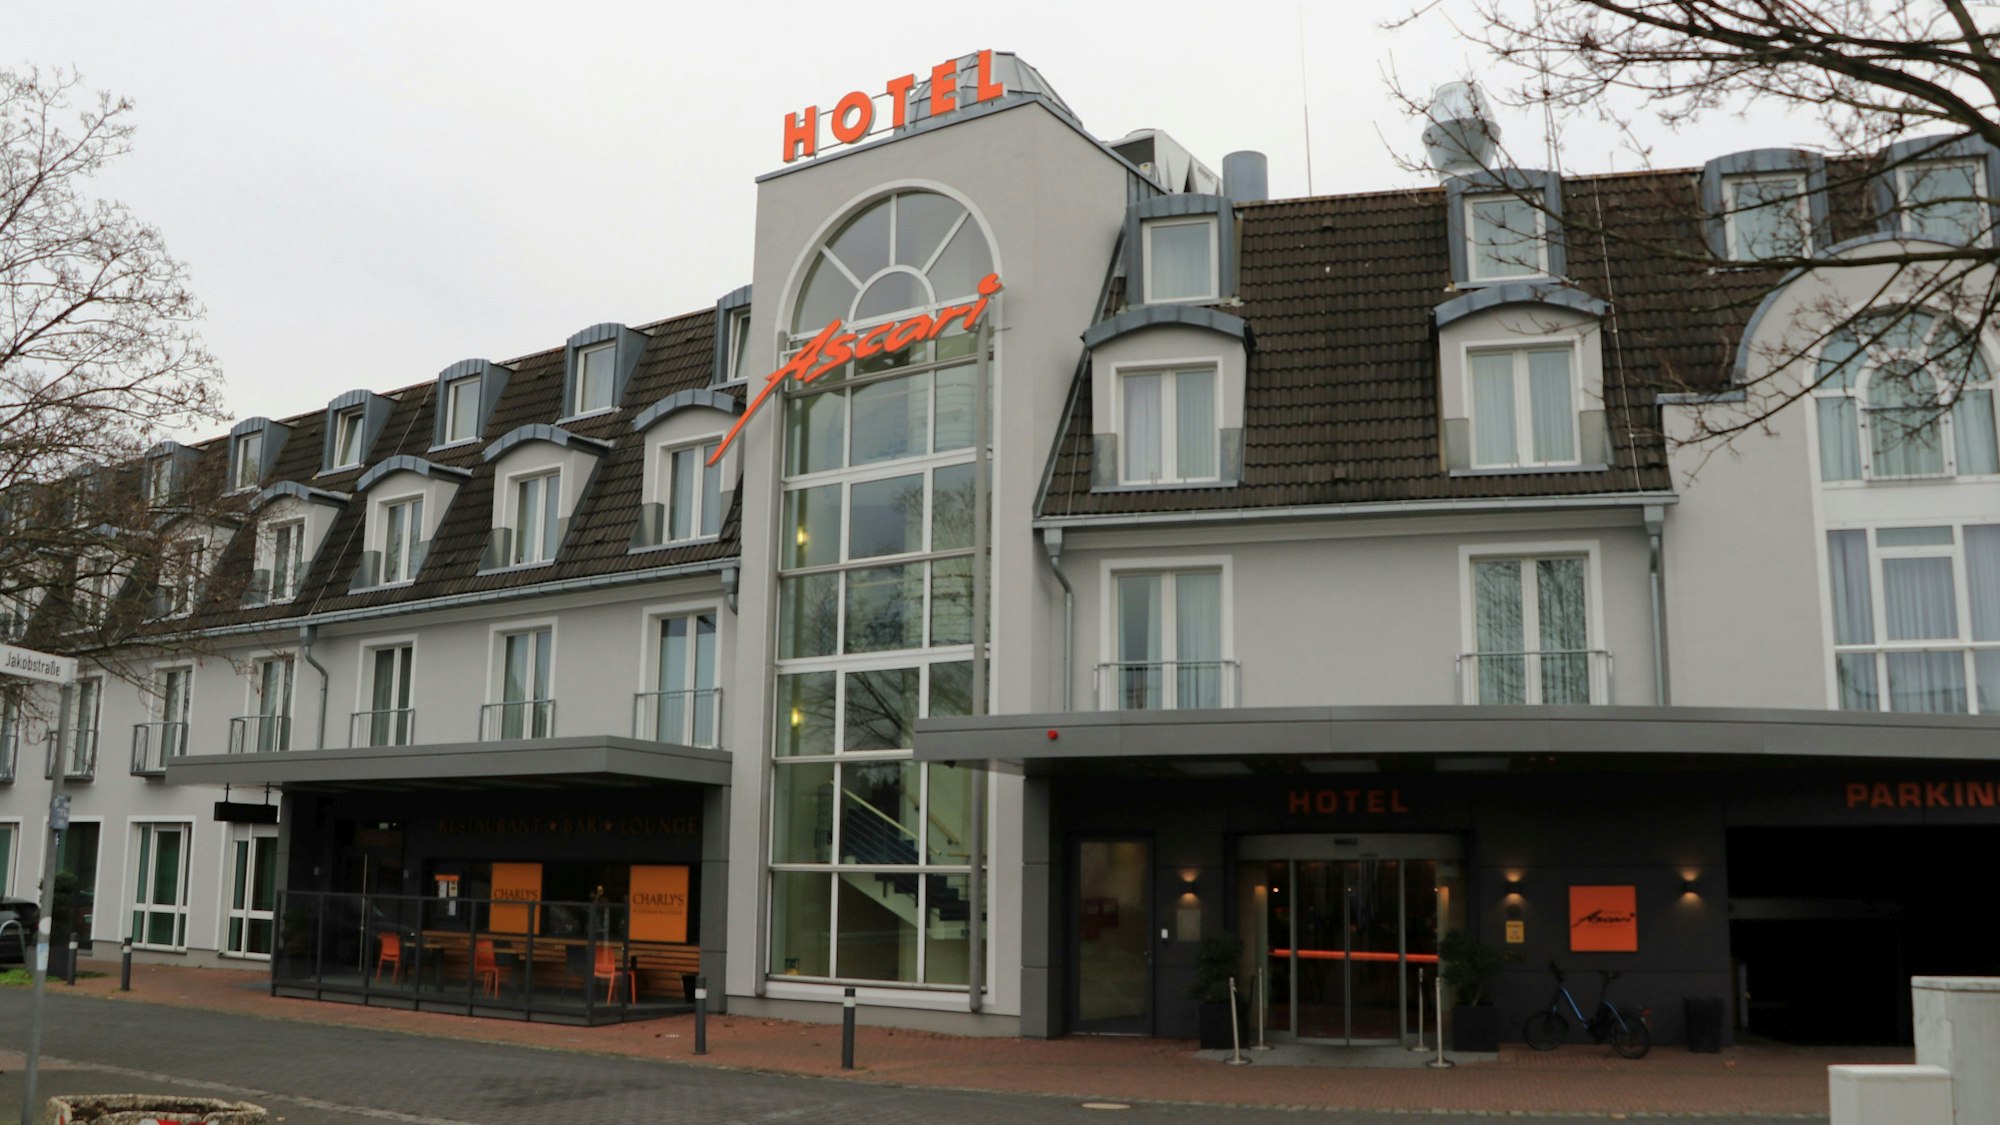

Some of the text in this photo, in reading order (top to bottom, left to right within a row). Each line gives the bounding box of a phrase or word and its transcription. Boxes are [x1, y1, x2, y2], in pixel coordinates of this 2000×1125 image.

[783, 49, 1006, 162] HOTEL
[707, 273, 1003, 467] Ascari
[5, 653, 61, 675] Jakobstraße
[1289, 790, 1409, 814] HOTEL
[1847, 782, 2000, 808] PARKIN
[438, 816, 698, 835] RESTAURANT BAR LOUNGE
[632, 892, 684, 906] CHARLY'S
